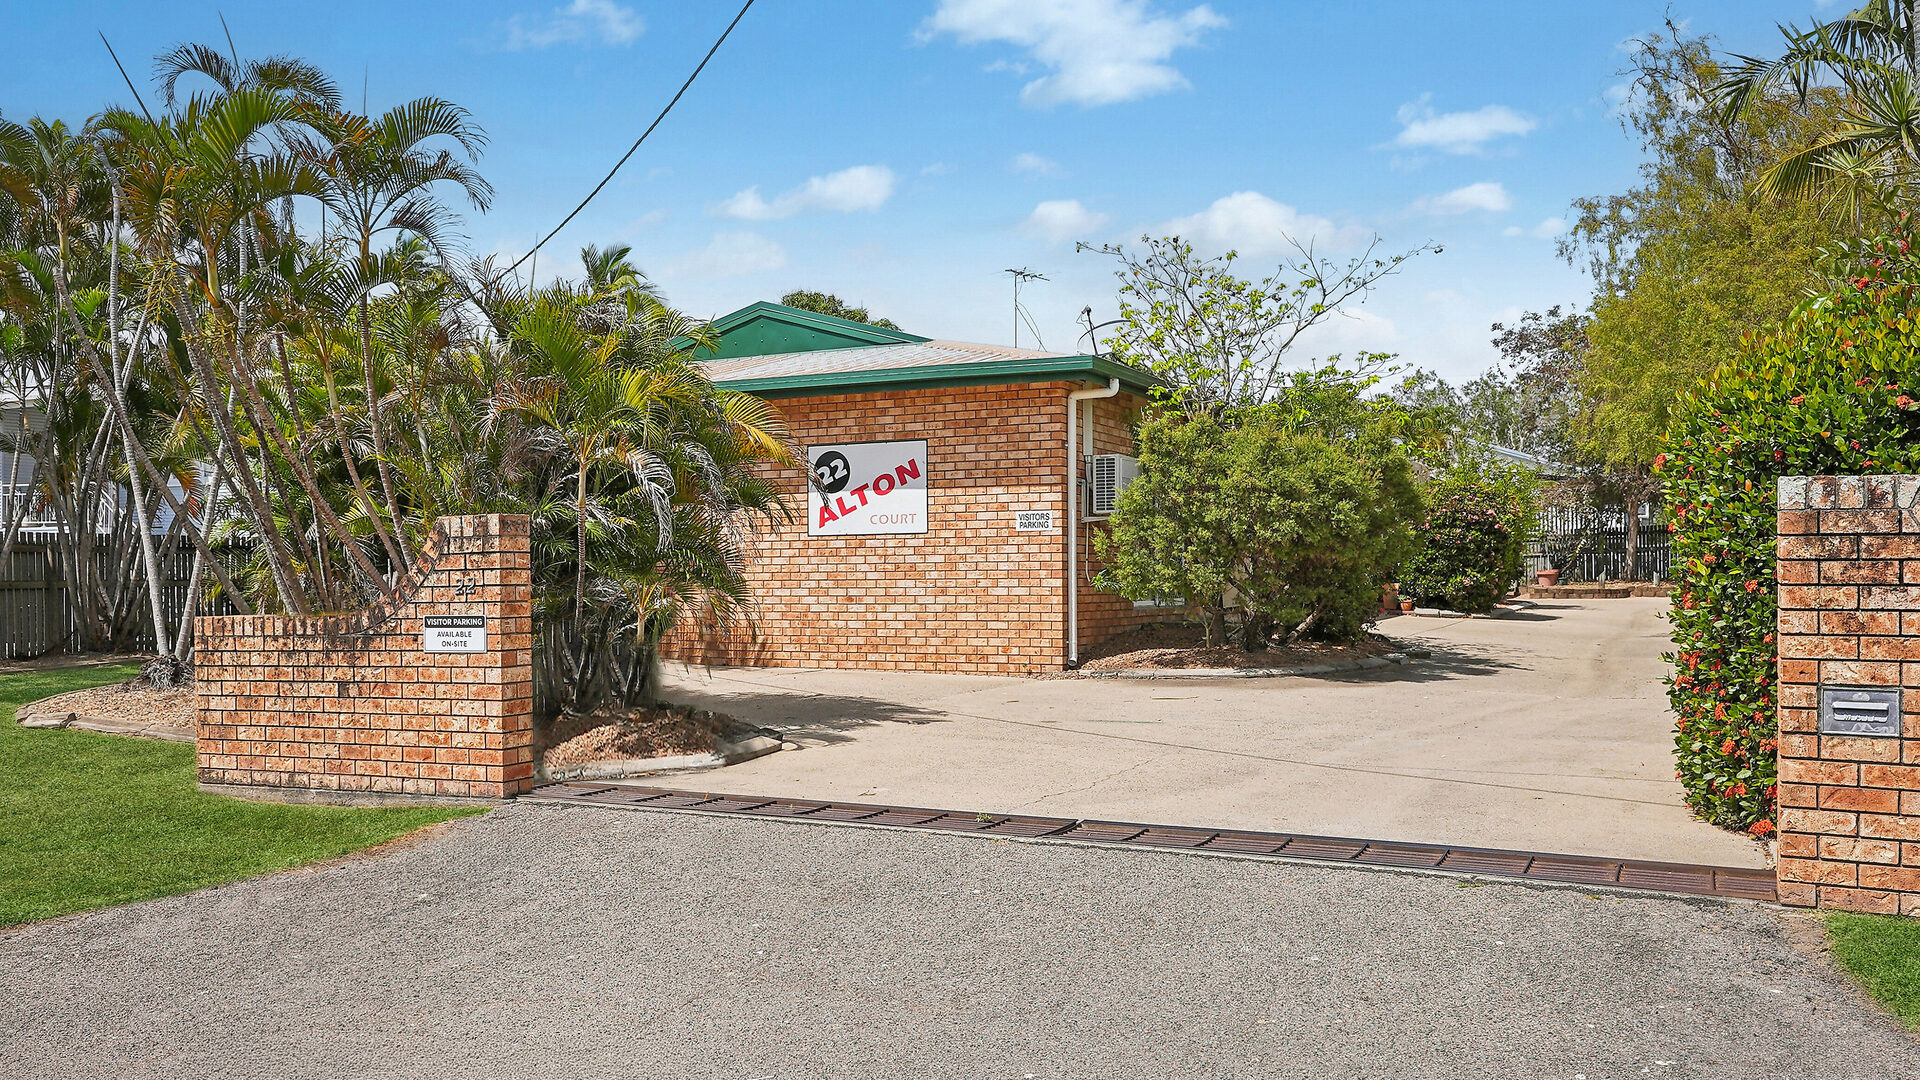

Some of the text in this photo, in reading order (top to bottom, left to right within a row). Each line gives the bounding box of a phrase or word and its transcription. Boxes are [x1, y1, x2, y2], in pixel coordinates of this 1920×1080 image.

[816, 458, 848, 486] 22
[819, 458, 921, 529] ALTON
[870, 513, 917, 525] COURT
[1018, 512, 1050, 521] VISITORS
[1019, 521, 1049, 529] PARKING
[455, 577, 477, 595] 22
[426, 618, 483, 626] VISITOR PARKING
[436, 630, 472, 638] AVAILABLE
